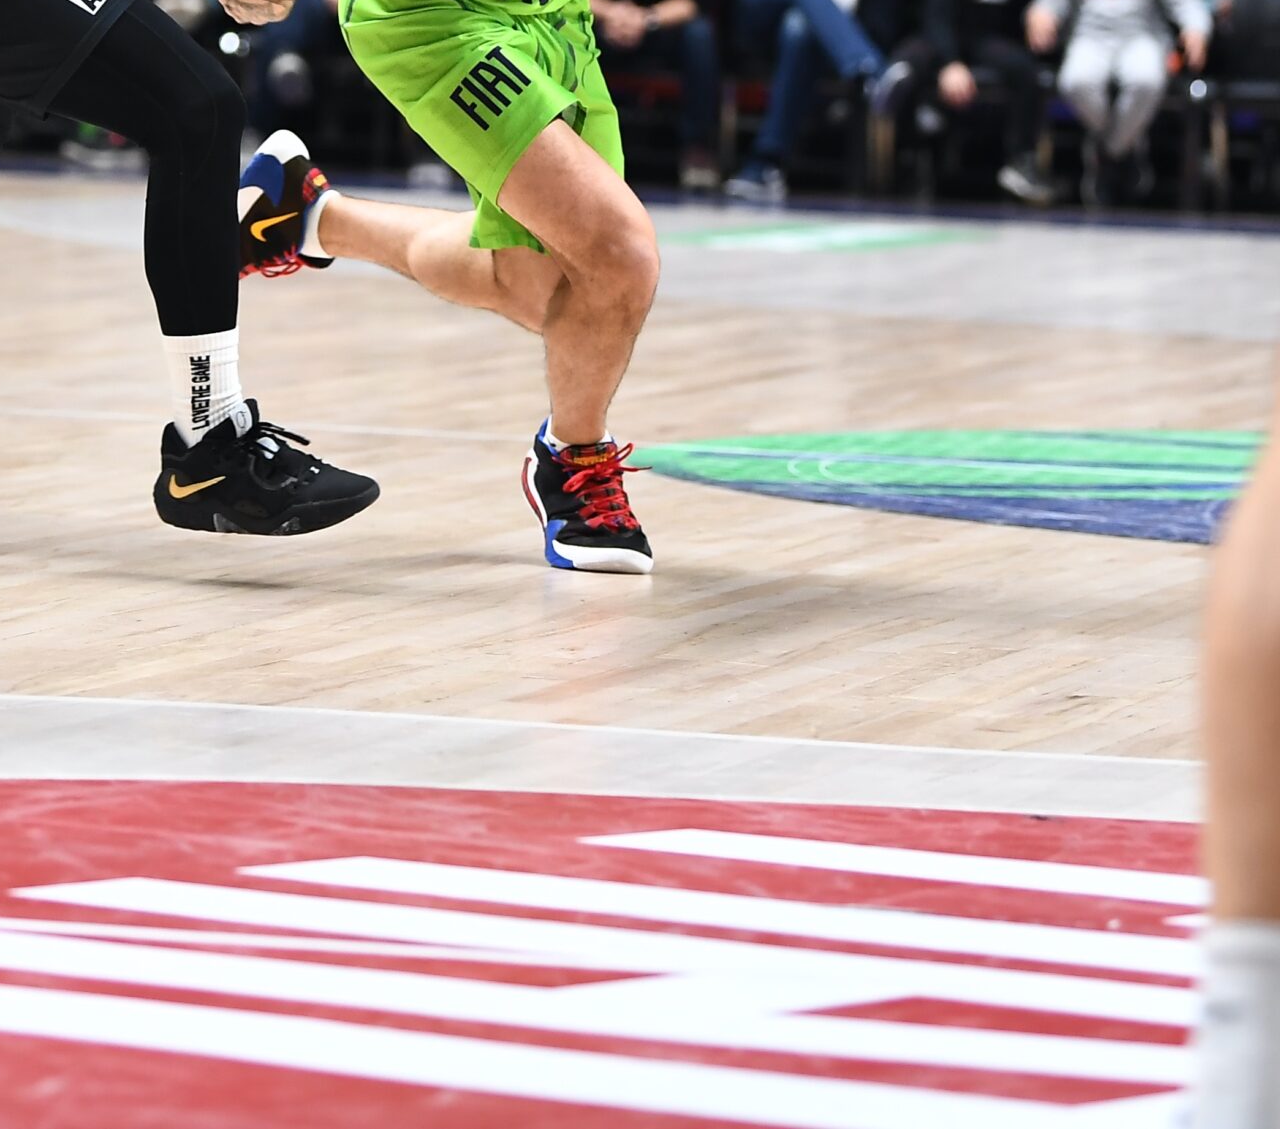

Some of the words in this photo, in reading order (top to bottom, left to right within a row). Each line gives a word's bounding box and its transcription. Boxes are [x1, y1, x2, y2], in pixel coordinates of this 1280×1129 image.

[449, 45, 532, 132] FIAT
[189, 355, 211, 384] GAME
[190, 384, 211, 403] THE
[190, 400, 211, 431] LOVE
